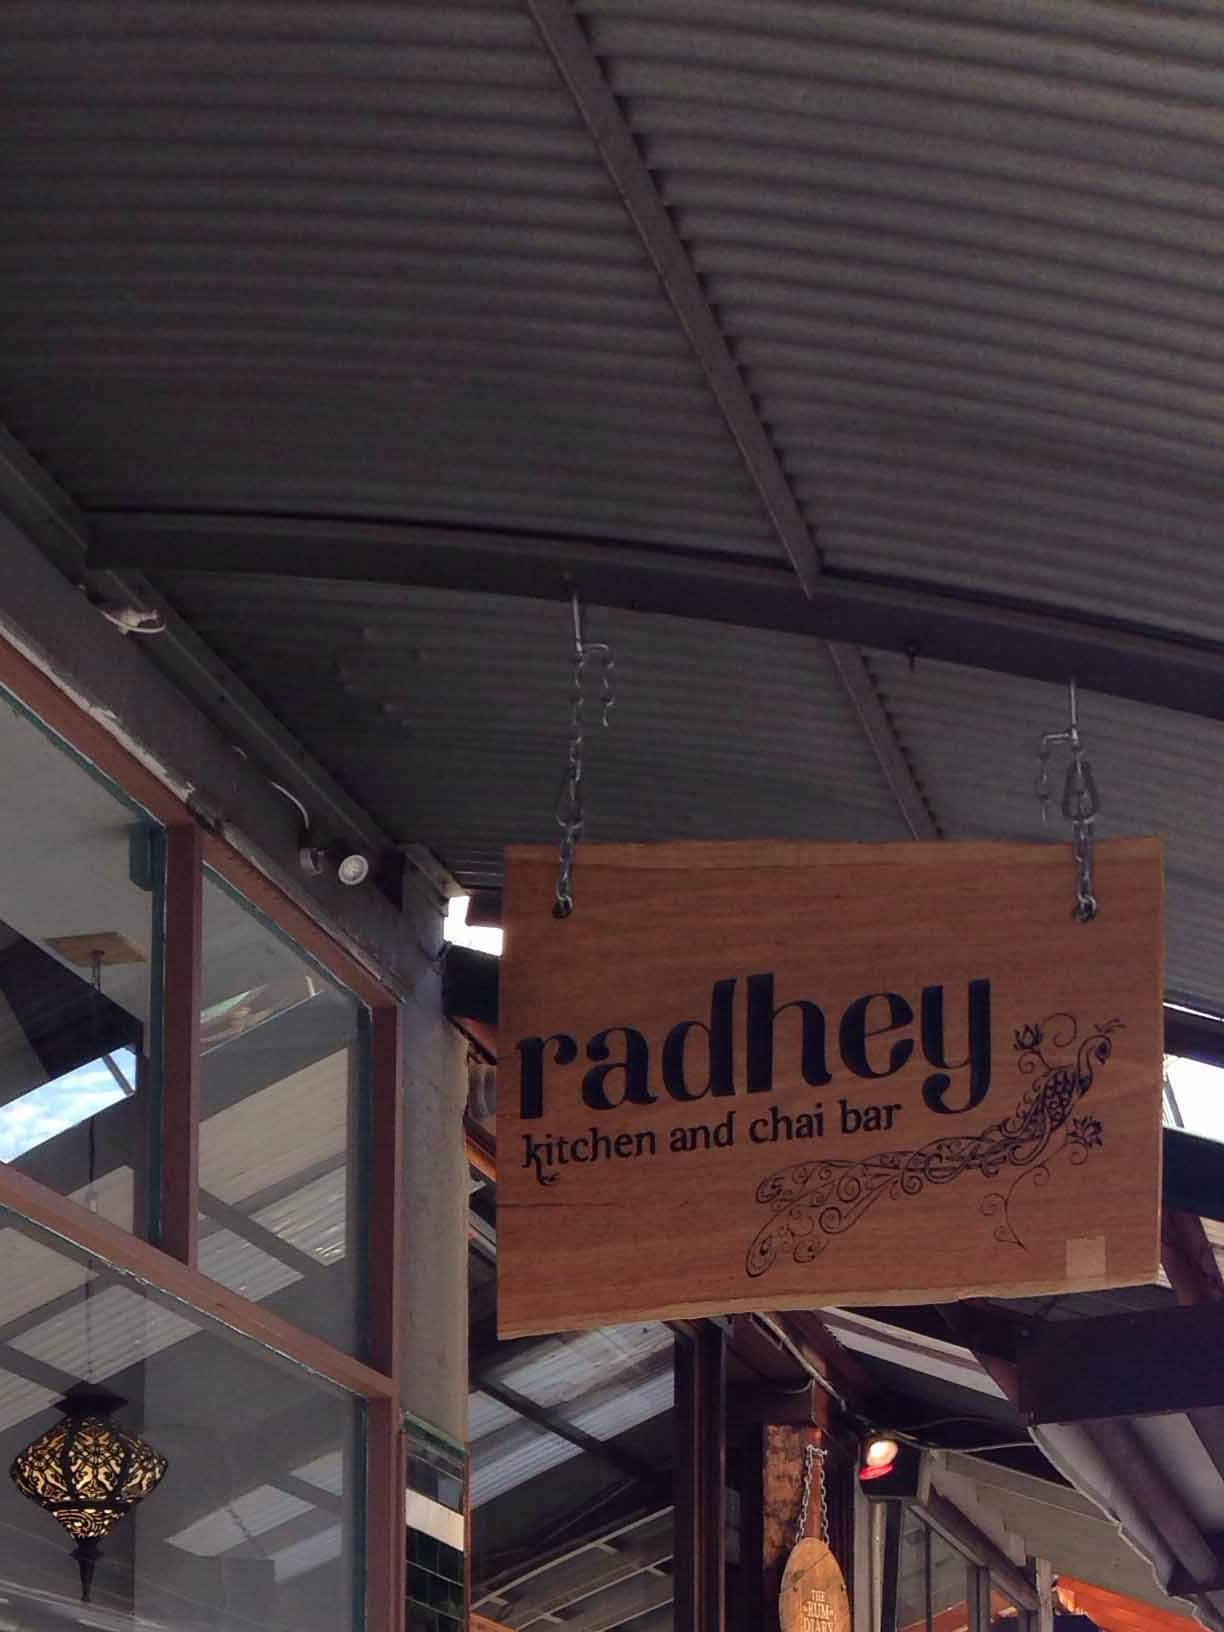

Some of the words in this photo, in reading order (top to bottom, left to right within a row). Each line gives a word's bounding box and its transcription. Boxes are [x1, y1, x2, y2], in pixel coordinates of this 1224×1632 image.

[516, 973, 991, 1118] radhey
[522, 1127, 656, 1186] kitchen
[669, 1112, 734, 1151] and
[749, 1105, 824, 1145] chai
[839, 1099, 902, 1136] bar
[808, 1601, 830, 1619] RUM
[811, 1590, 826, 1602] THE
